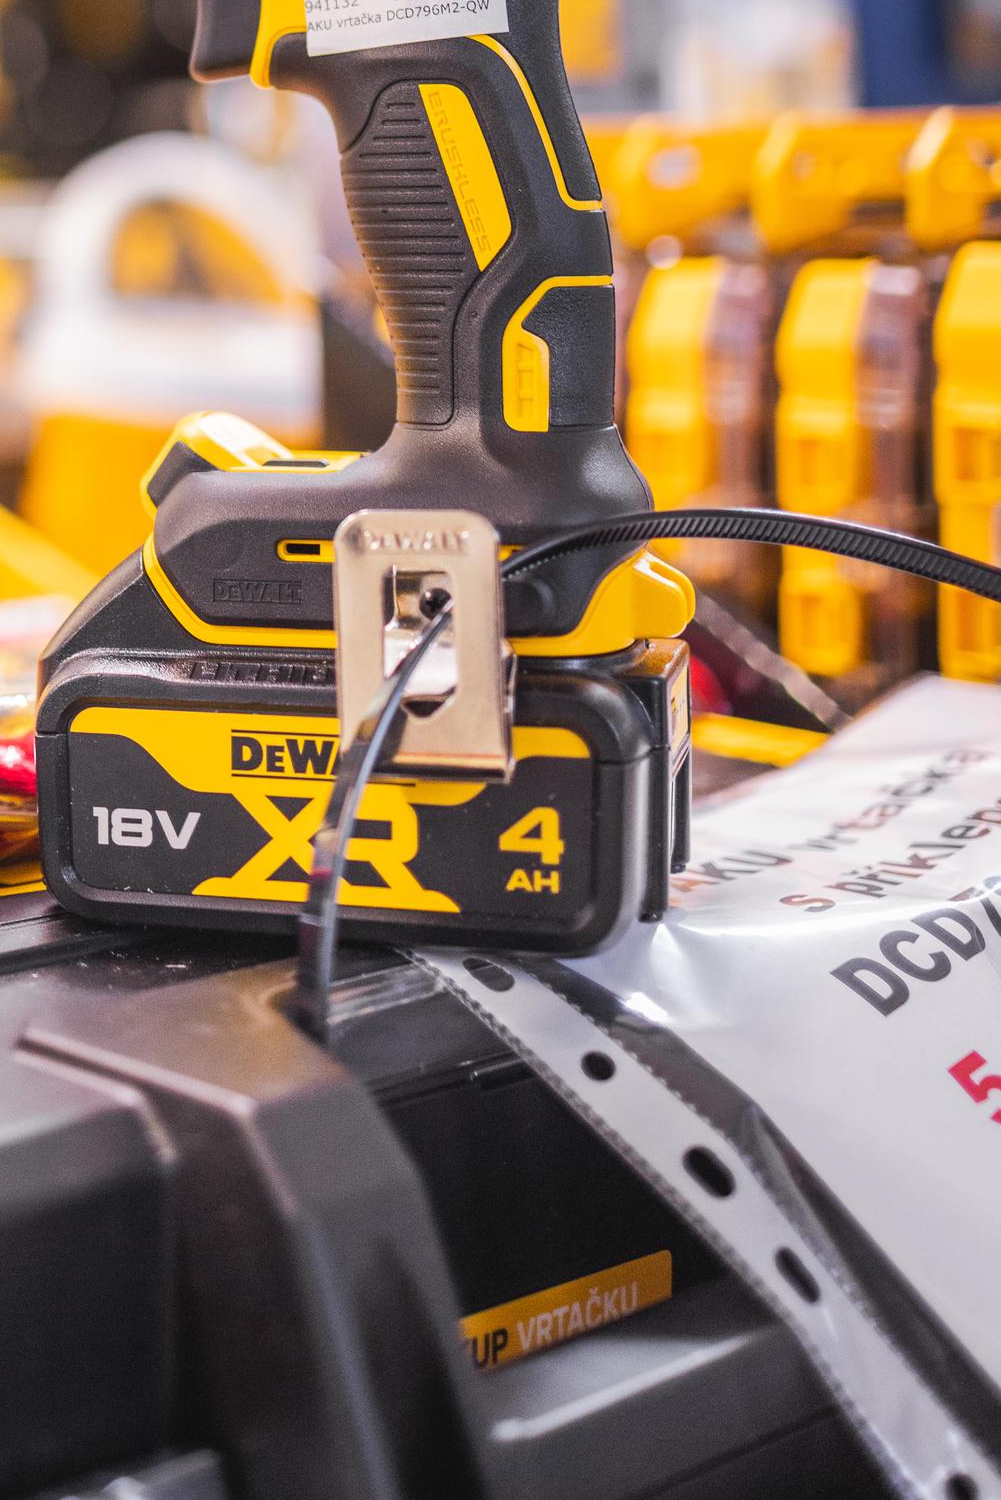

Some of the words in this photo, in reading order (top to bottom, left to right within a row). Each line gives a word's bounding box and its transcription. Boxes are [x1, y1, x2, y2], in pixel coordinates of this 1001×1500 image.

[306, 19, 332, 33] AKU
[336, 11, 382, 28] vrtačka
[386, 0, 490, 22] DCD796M2-QW
[231, 735, 342, 777] DEW
[93, 806, 201, 850] 18V
[192, 792, 461, 913] XR
[498, 806, 565, 866] 4
[505, 868, 560, 894] AH
[829, 875, 1001, 1017] DCD7
[463, 1328, 508, 1367] UP
[516, 1280, 641, 1350] VRTAČKU
